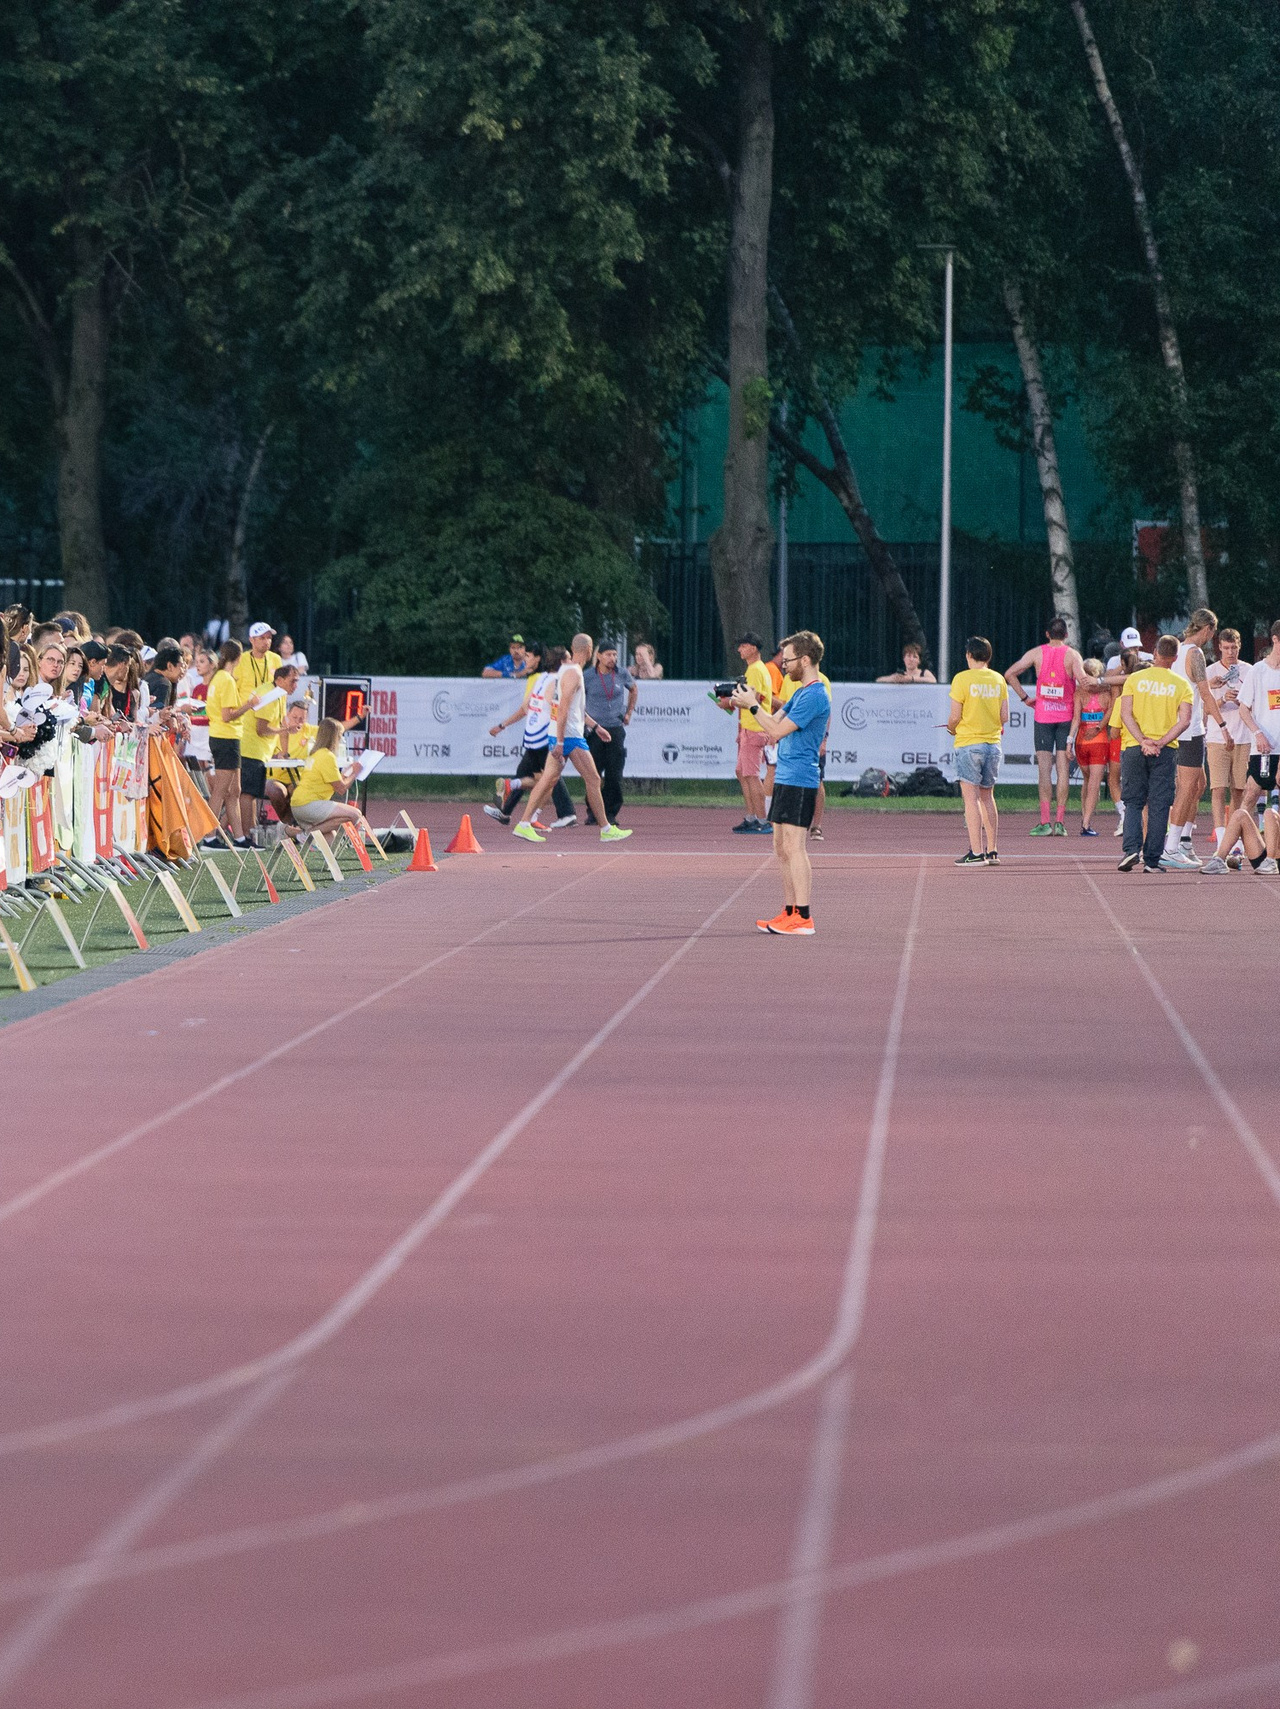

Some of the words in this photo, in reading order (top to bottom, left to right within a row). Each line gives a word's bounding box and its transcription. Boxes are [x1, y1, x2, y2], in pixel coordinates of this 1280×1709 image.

[969, 683, 1001, 698] СУДЬЯ
[1137, 679, 1177, 697] СУДЬЯ
[371, 690, 398, 715] ТВА
[633, 706, 691, 716] ЧЕМПИОНАТ
[859, 708, 934, 719] SYNCROSFERA
[370, 717, 398, 735] ОВЫХ
[901, 752, 954, 765] GEL4
